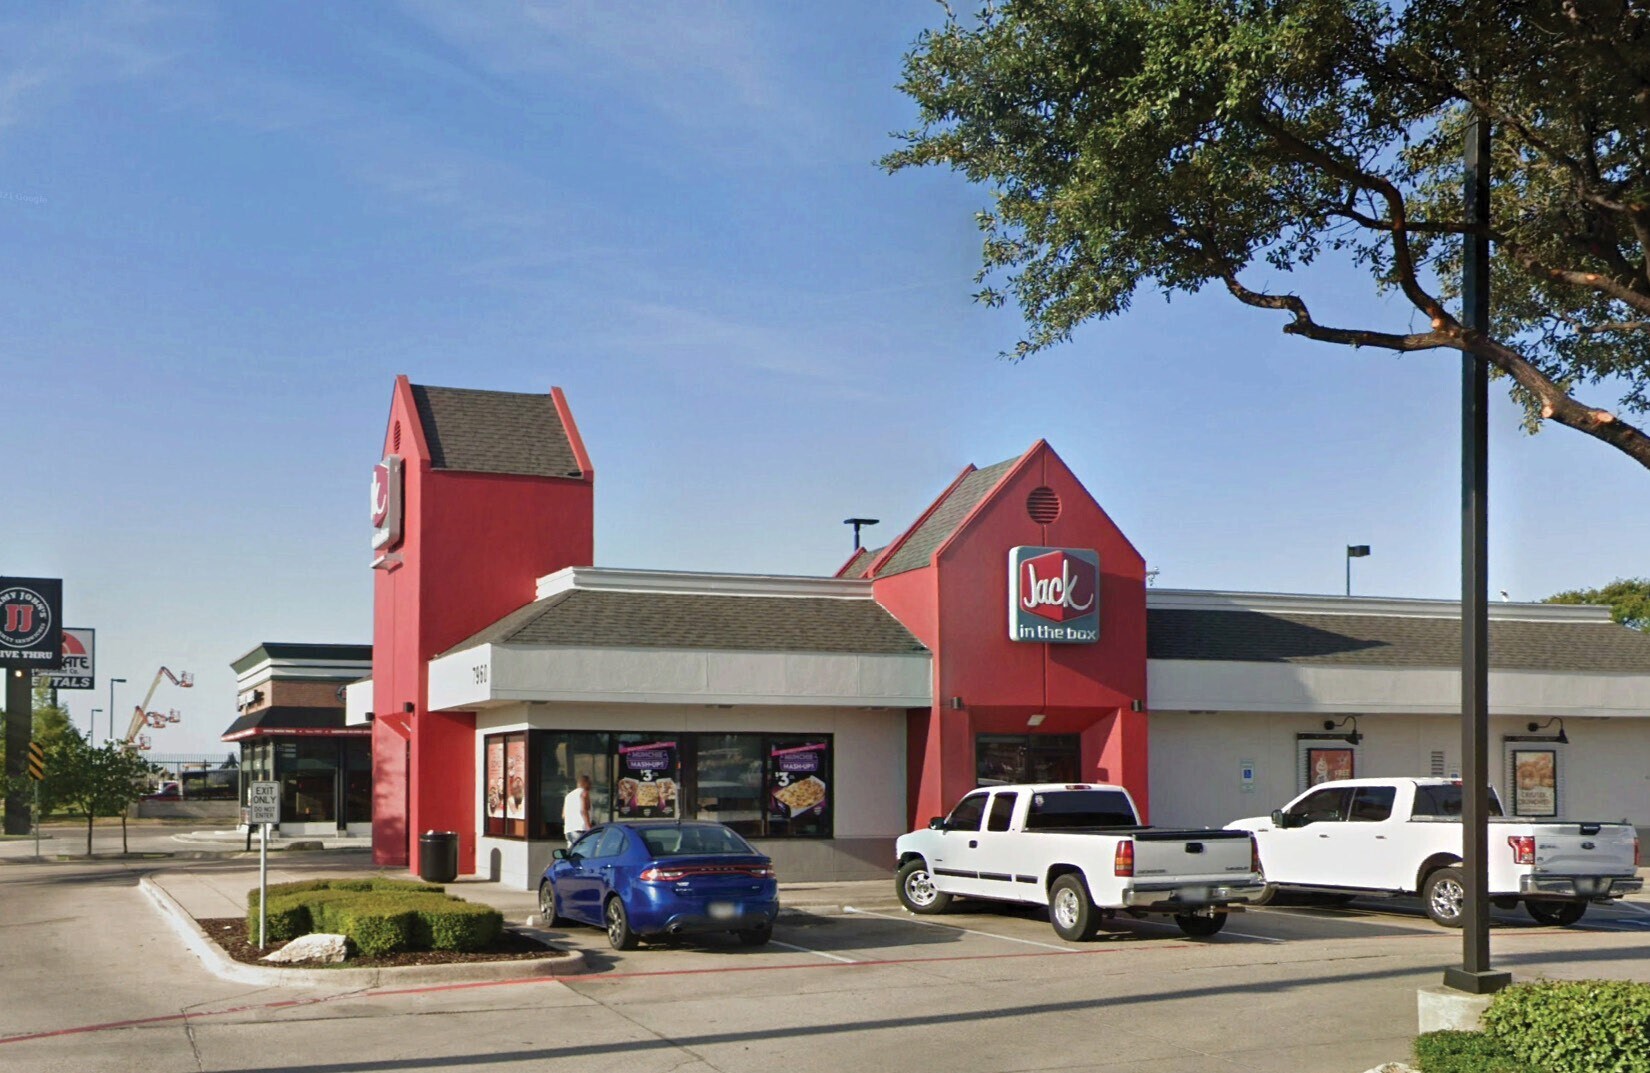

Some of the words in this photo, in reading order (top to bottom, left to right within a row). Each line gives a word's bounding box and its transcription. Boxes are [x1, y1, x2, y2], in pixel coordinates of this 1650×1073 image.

[1023, 559, 1094, 611] Jack
[1019, 624, 1035, 638] in
[1037, 625, 1064, 639] the
[1067, 627, 1096, 640] box
[21, 651, 53, 660] THRU
[62, 656, 90, 669] ATE
[256, 786, 274, 795] EXIT
[253, 795, 276, 804] ONLY
